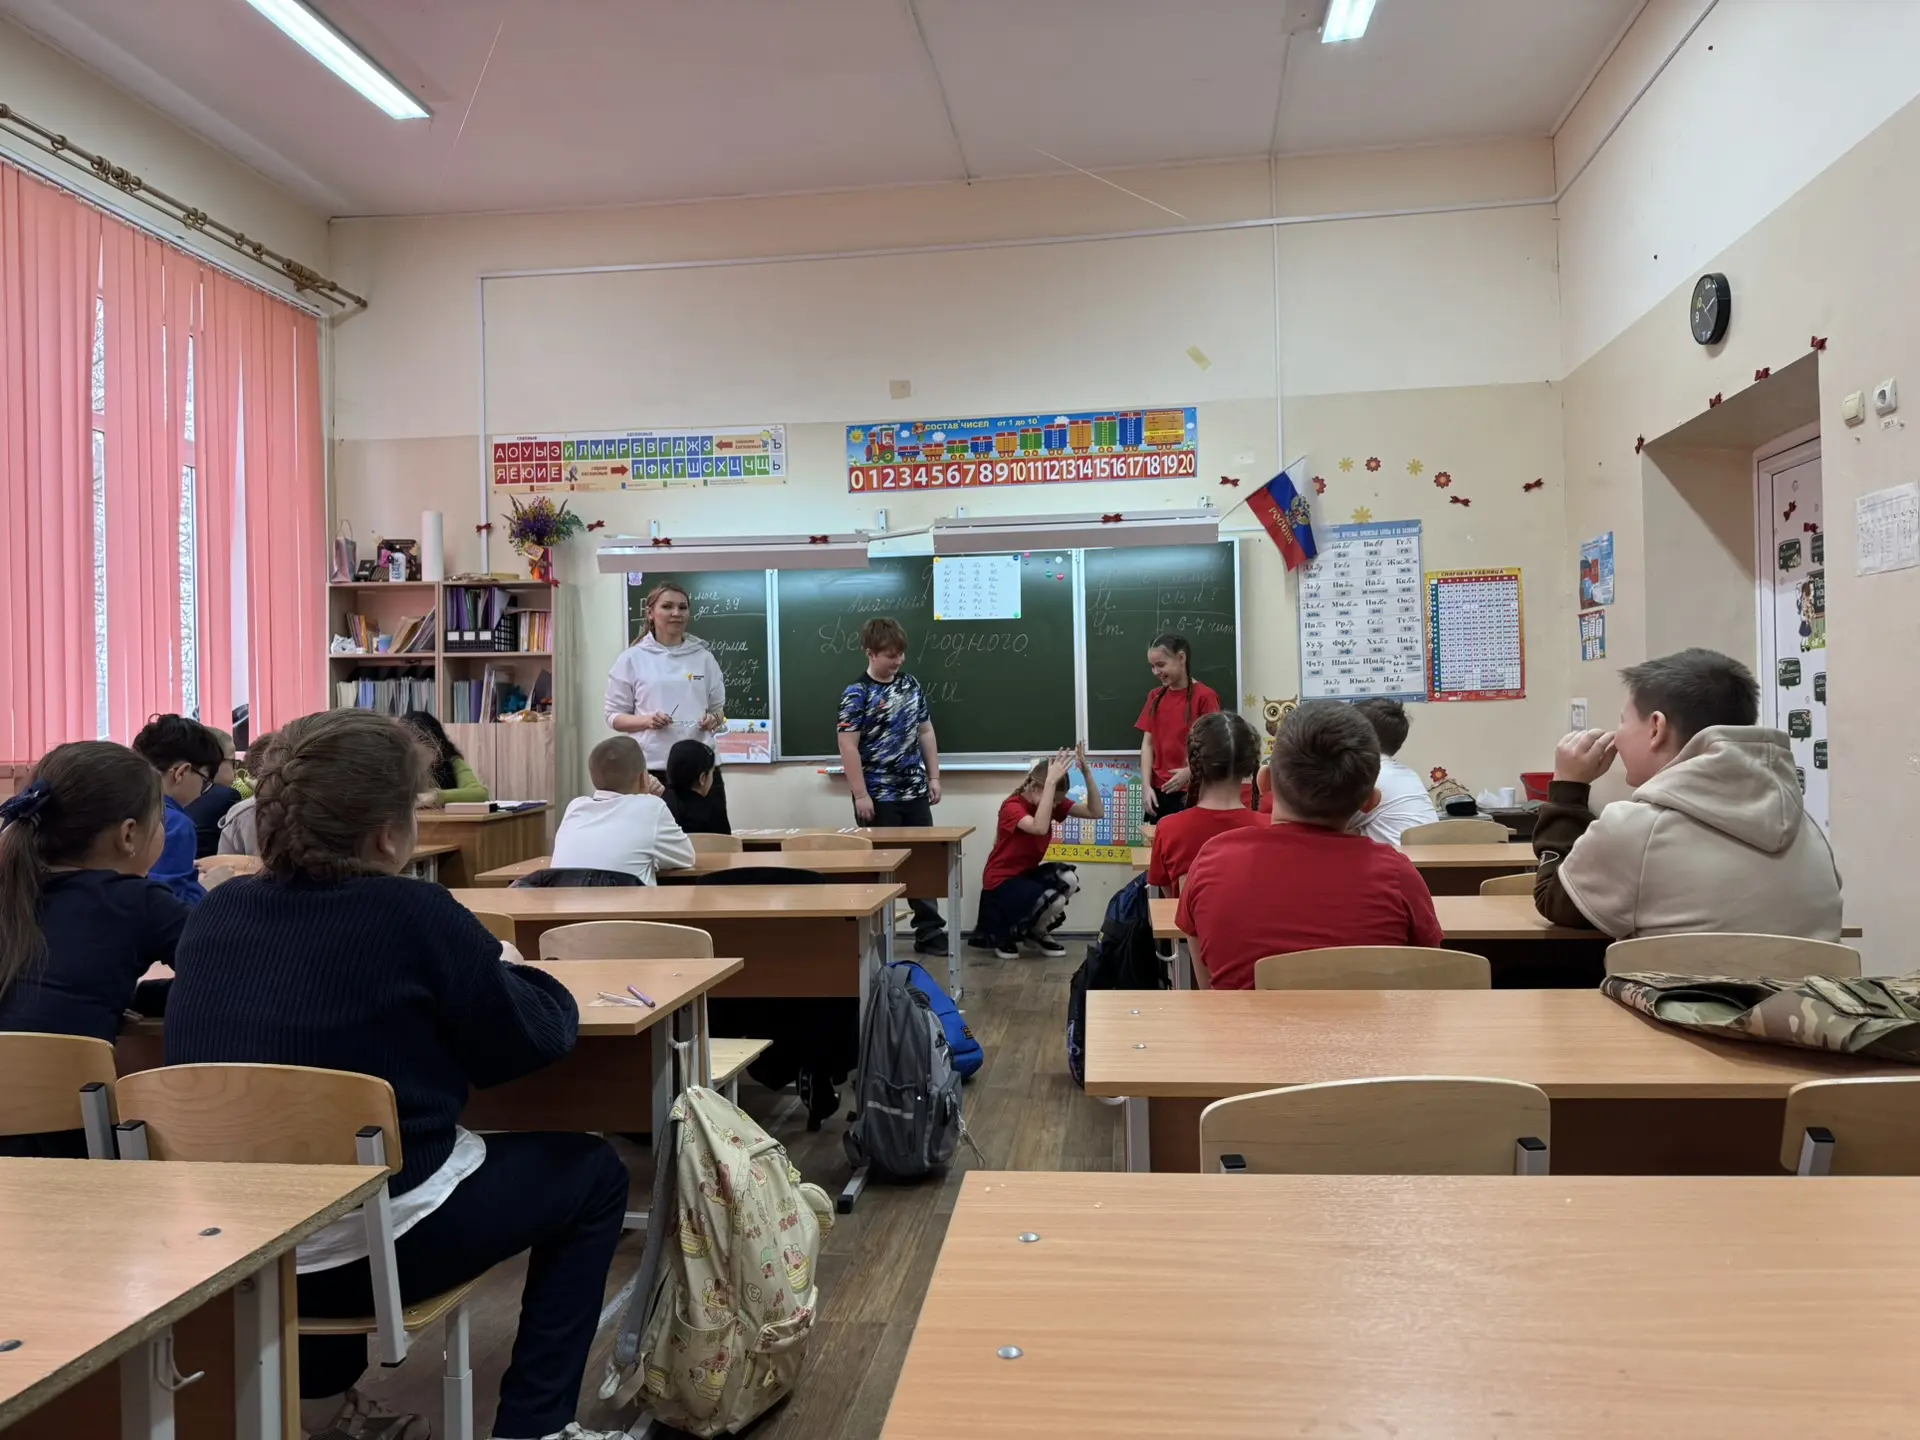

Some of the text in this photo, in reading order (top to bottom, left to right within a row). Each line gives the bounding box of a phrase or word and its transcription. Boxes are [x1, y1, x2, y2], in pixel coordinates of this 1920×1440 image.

[925, 422, 958, 431] СОСТАВ
[960, 420, 989, 429] ЧИСЕЛ
[1027, 417, 1037, 425] 10
[495, 439, 782, 458] А О У Ы Э Й Л М Н Р Б В Г Д Ж З Ъ
[496, 458, 780, 480] Я Ё Ю И Е П Ф К Т Ш С Х Ц Ч Щ Ь
[851, 454, 1194, 489] 0 1 2 3 4 5 6 7 8 9 10 11 12 13 14 15 16 17 18 19 20
[1268, 506, 1293, 544] РОССИЯ
[815, 615, 1029, 668] Де родного
[1052, 847, 1125, 857] 1 2 3 4 5 6 7
